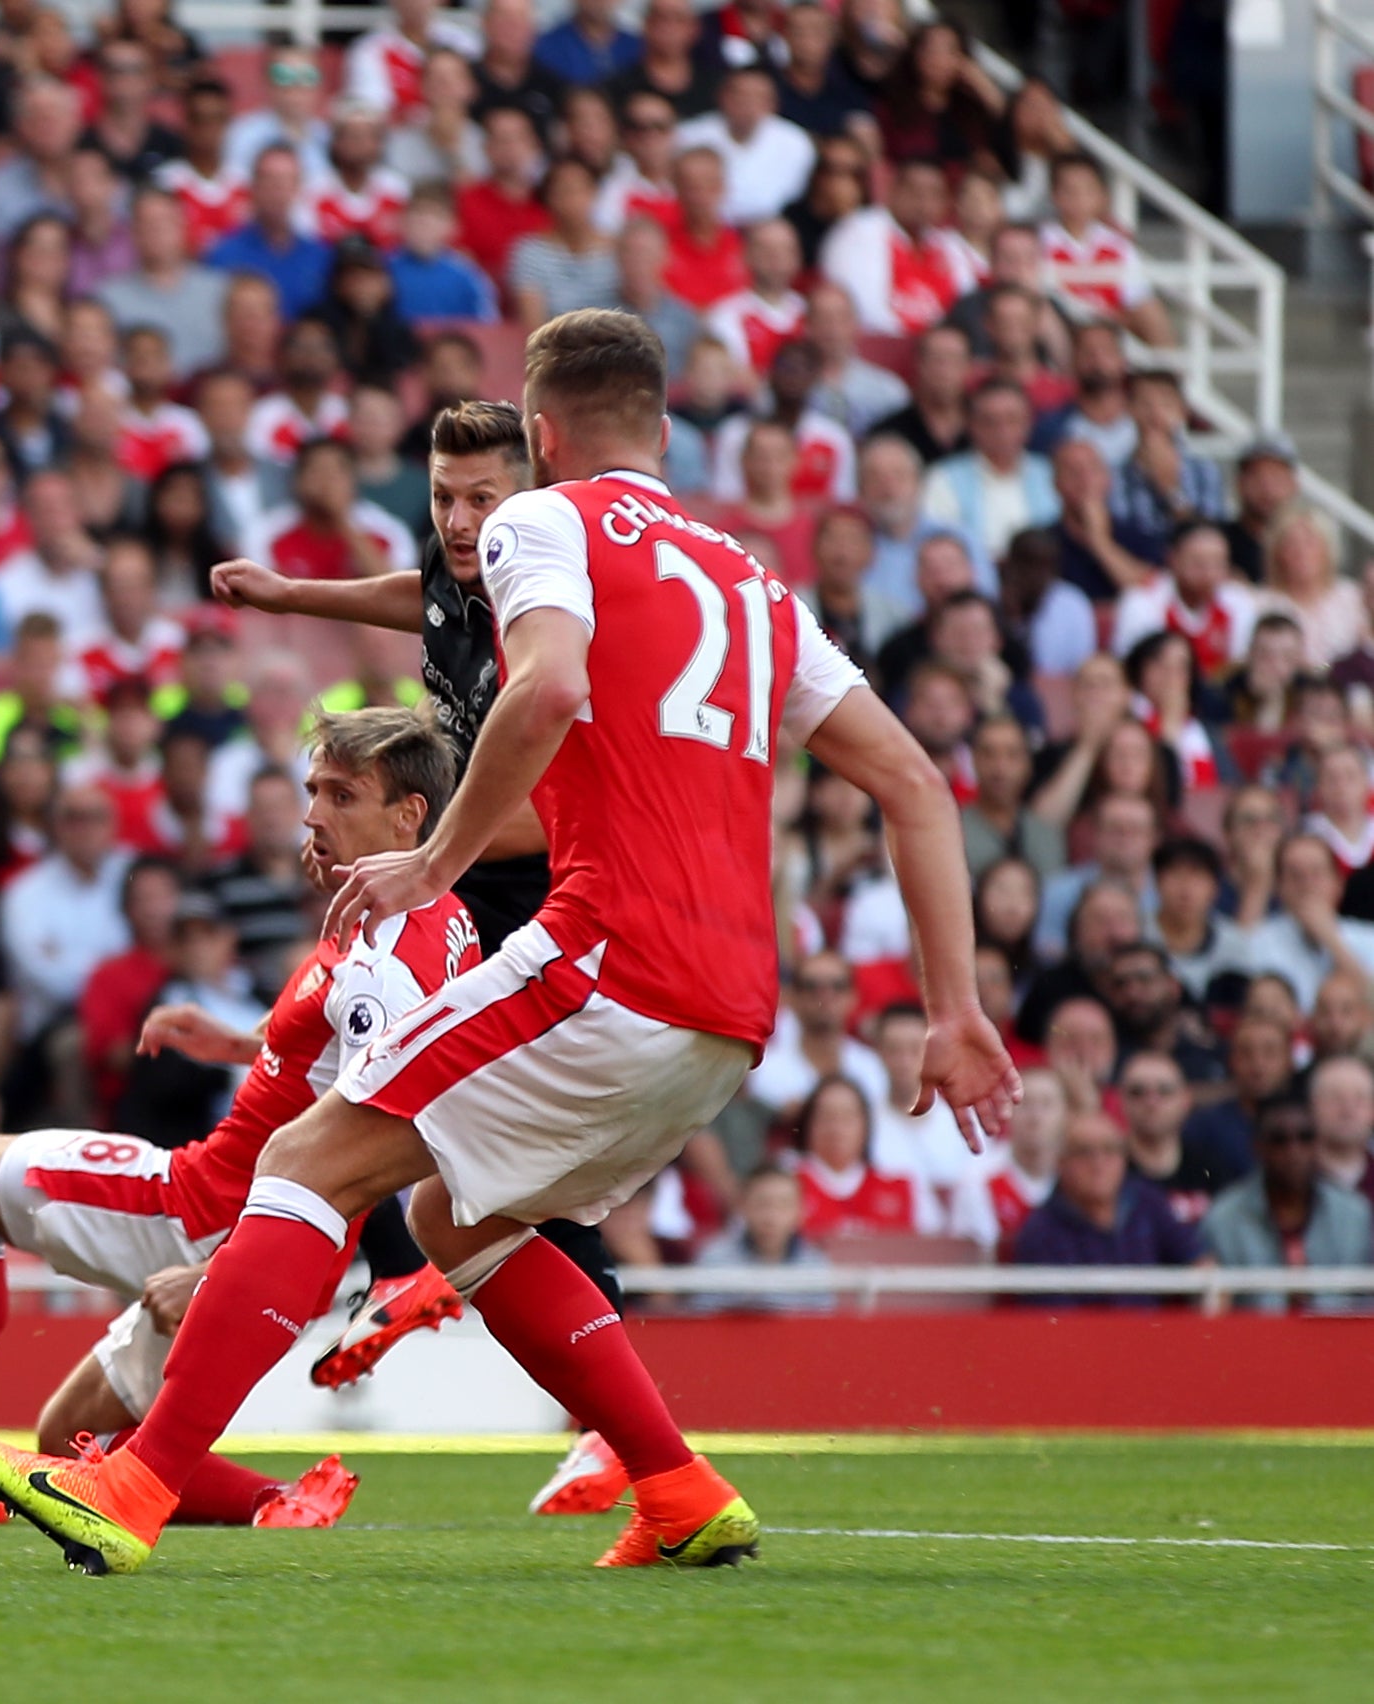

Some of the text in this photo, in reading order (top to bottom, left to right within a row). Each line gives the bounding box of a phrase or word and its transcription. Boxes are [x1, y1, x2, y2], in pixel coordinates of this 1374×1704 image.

[652, 539, 776, 768] 21
[444, 908, 479, 981] ONRE
[81, 1139, 141, 1164] 8
[262, 1307, 303, 1338] ARSE
[570, 1312, 622, 1345] ARSEN
